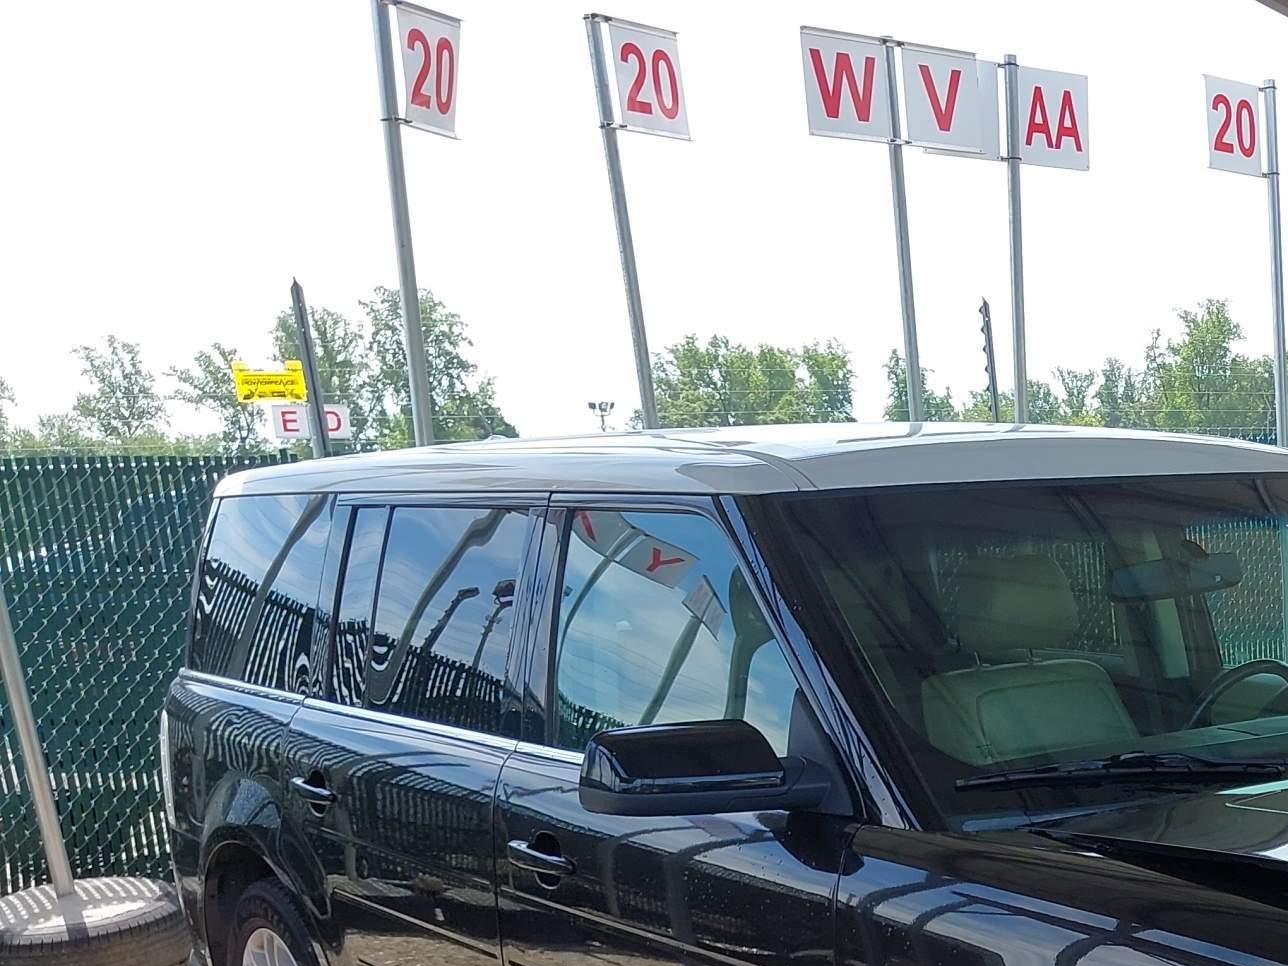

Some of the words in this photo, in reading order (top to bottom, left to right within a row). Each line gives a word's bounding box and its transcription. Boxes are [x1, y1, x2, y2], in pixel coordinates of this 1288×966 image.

[408, 28, 454, 114] 20
[619, 41, 680, 122] 20
[809, 48, 876, 123] W
[919, 64, 962, 132] V
[1025, 86, 1083, 152] AA
[1212, 94, 1256, 158] 20
[281, 411, 299, 432] E
[322, 411, 342, 432] D
